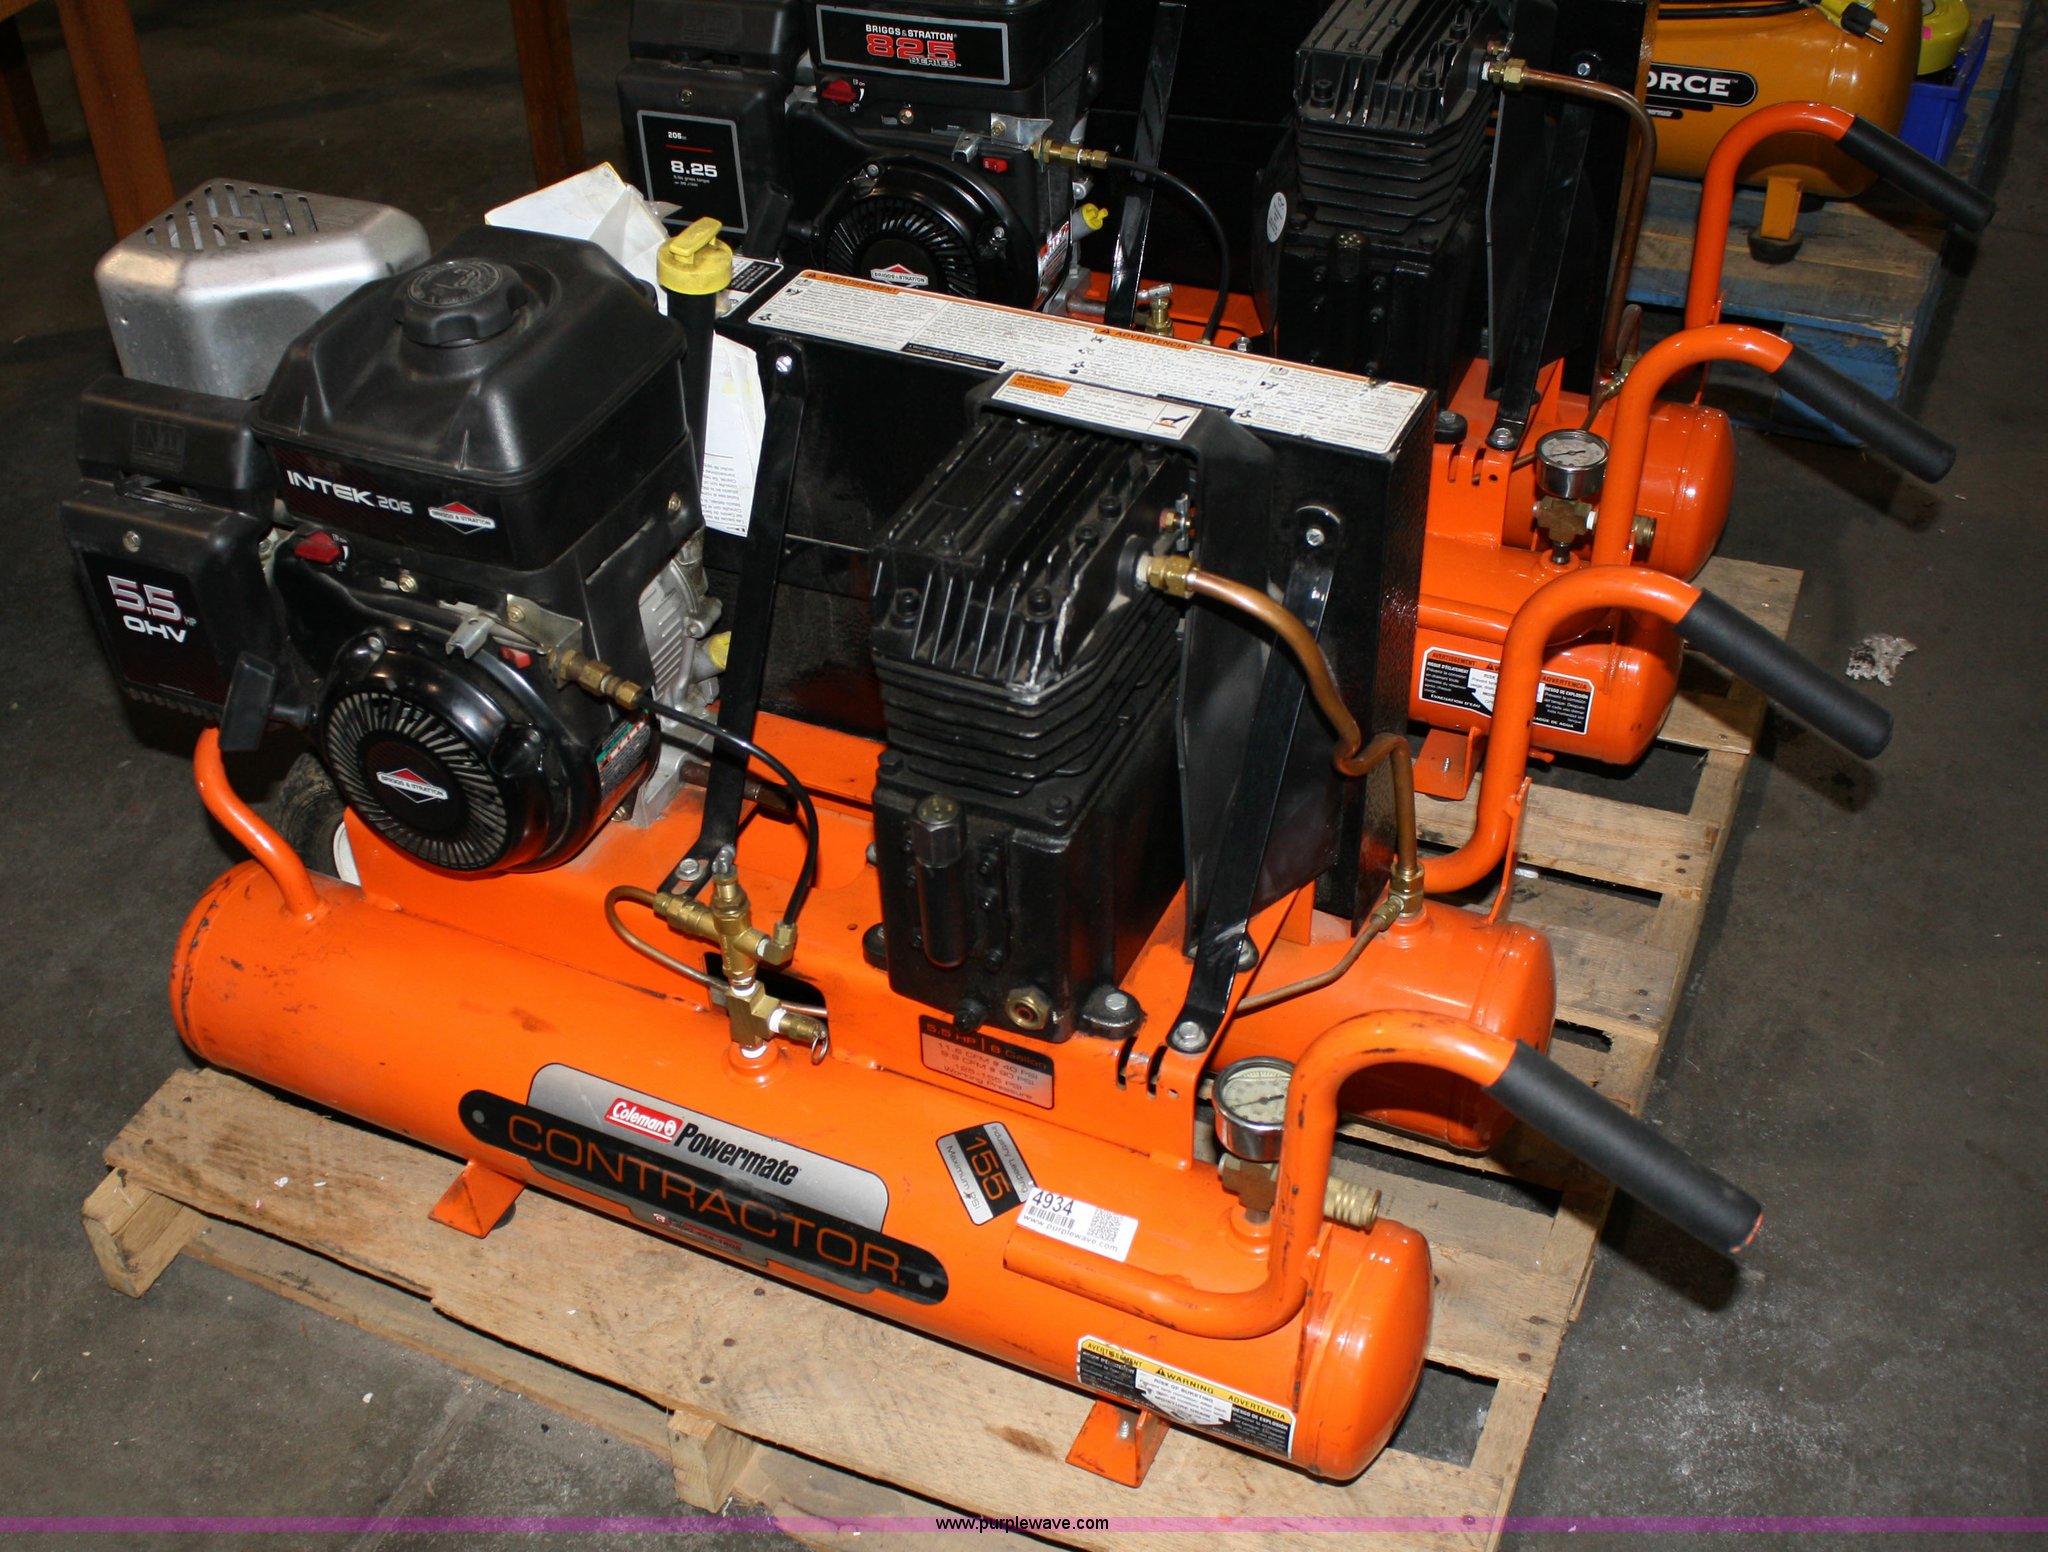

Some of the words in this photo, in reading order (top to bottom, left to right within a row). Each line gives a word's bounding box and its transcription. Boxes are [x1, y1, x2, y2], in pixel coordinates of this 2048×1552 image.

[866, 33, 957, 61] 825
[670, 160, 718, 178] 8.25
[1115, 330, 1188, 349] ADVERTENCIA
[286, 469, 375, 507] INTEK
[375, 495, 413, 515] 206
[123, 615, 187, 643] OHV
[612, 1101, 666, 1133] Coleman
[673, 1122, 799, 1186] Powermate
[990, 1125, 1010, 1158] Industry
[1008, 1157, 1029, 1193] Leading
[946, 1144, 970, 1191] Maximum
[965, 1136, 1011, 1201] 155
[508, 1114, 902, 1284] CONTRACTOR
[1032, 1189, 1075, 1216] 4934
[1023, 1213, 1119, 1253] www.purplewave.com
[1166, 1371, 1215, 1395] WARNING
[1228, 1394, 1286, 1421] ADVERTENCIA
